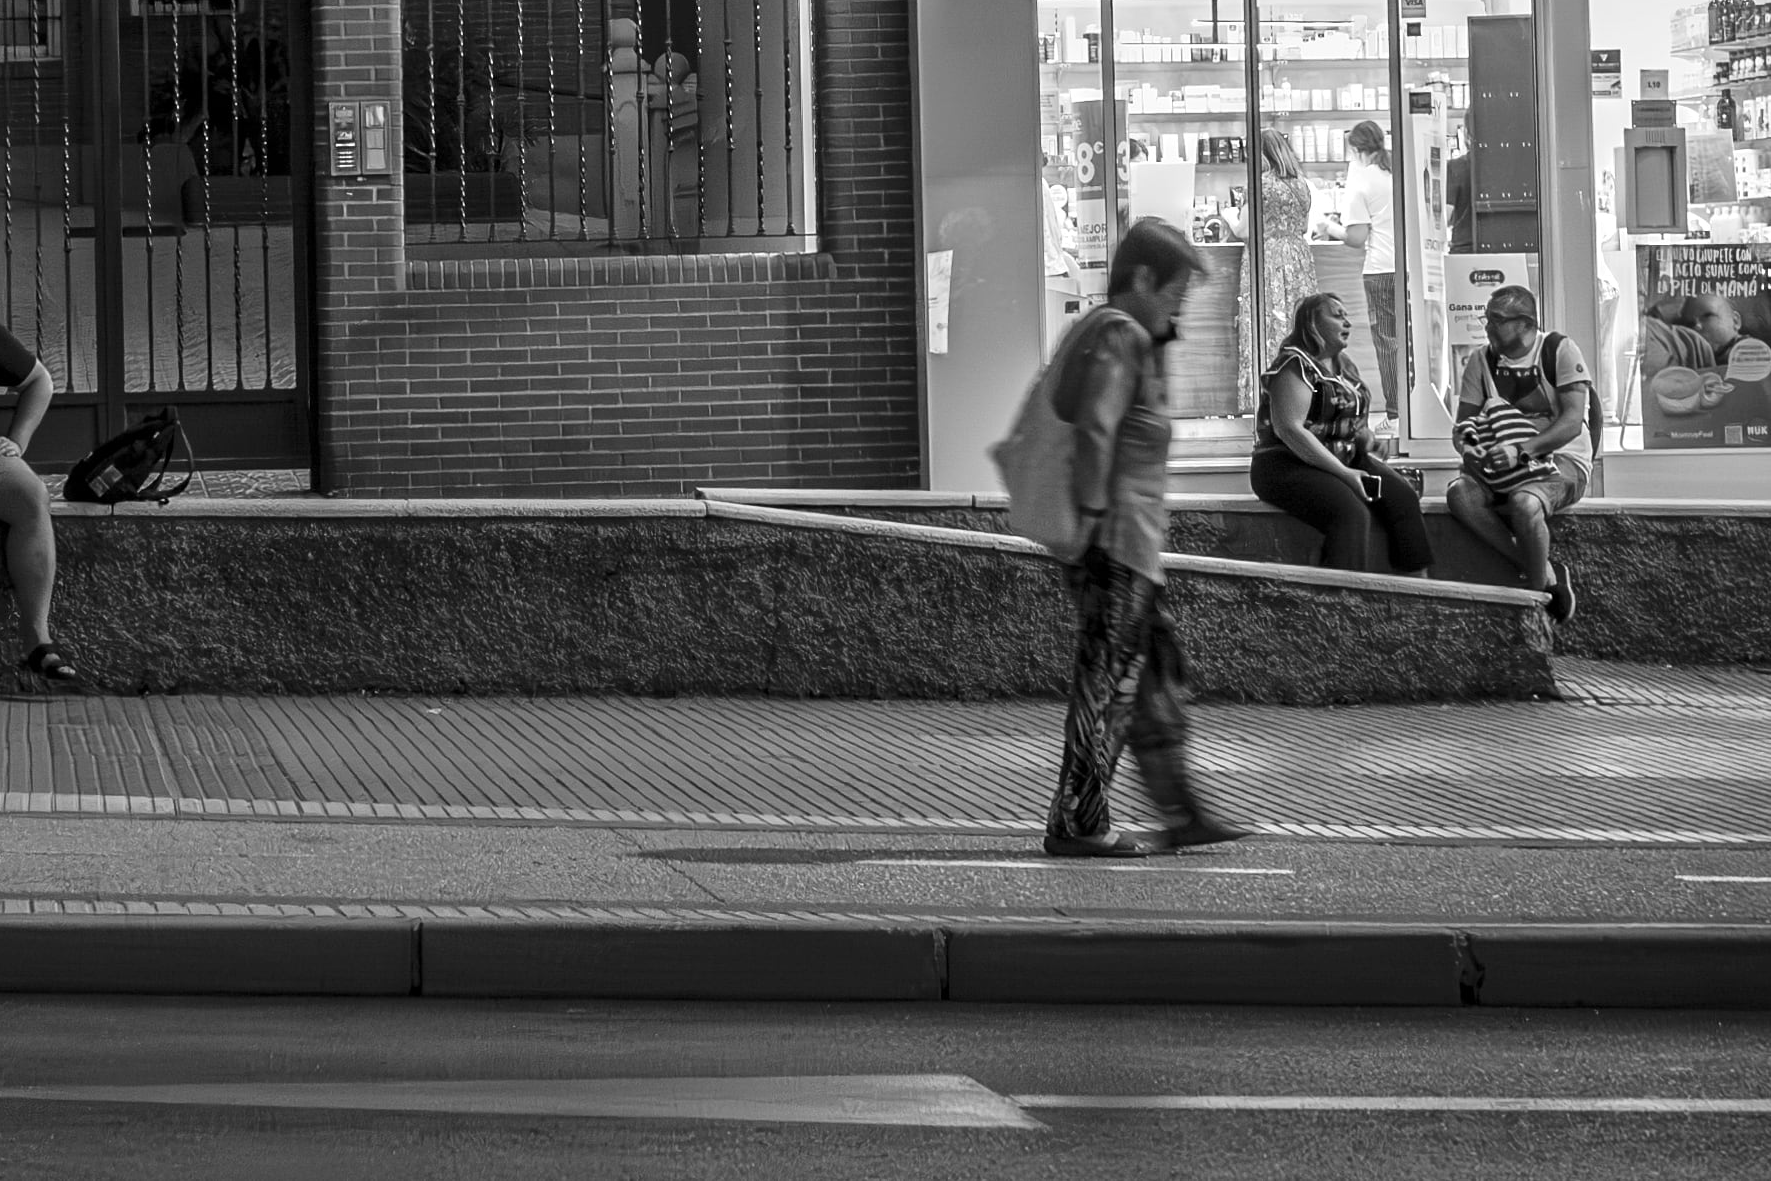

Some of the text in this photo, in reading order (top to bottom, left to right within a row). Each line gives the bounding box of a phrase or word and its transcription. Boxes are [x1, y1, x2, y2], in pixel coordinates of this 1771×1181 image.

[1668, 246, 1695, 261] UEVO
[1696, 247, 1734, 263] CHUPETE
[1735, 248, 1752, 262] CON
[1671, 262, 1764, 279] ACTO SUAVE COMO
[1670, 278, 1697, 298] PIEL
[1715, 275, 1757, 298] MAMÁ
[1448, 303, 1486, 312] Gana un
[1747, 425, 1768, 436] NUK
